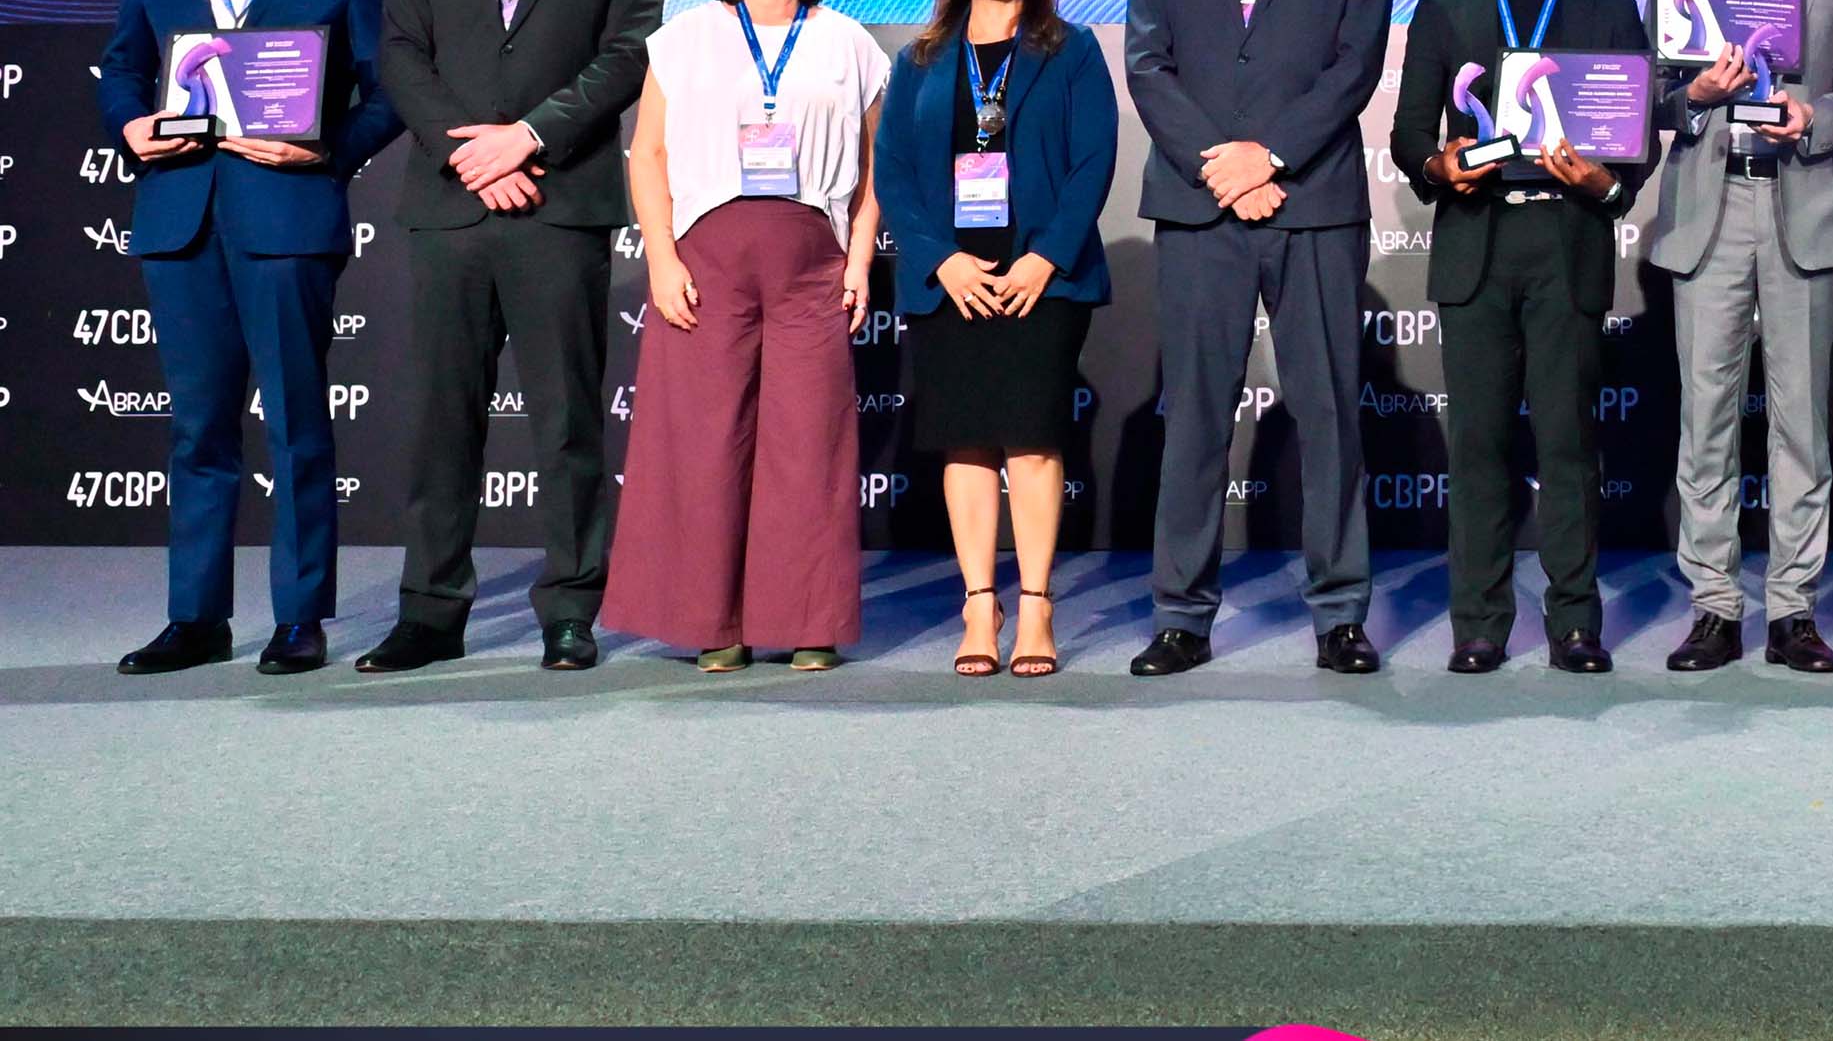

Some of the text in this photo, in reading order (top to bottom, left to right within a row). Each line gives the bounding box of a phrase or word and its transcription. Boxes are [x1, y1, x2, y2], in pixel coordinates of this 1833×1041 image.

[73, 309, 157, 346] 47CB
[77, 380, 172, 417] ABRAP
[67, 471, 171, 508] 47CBP
